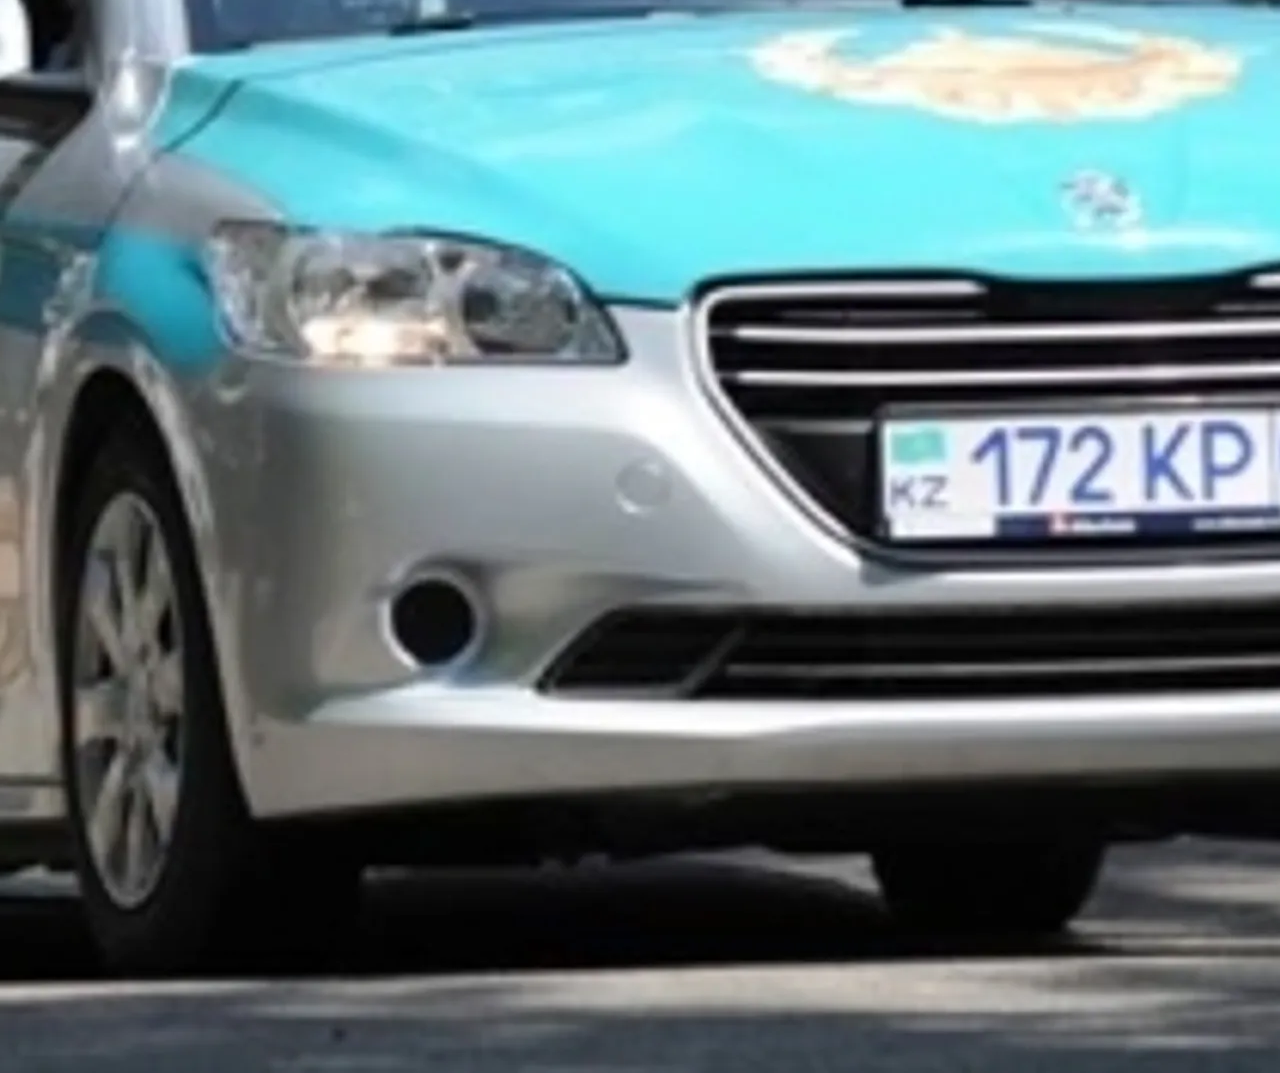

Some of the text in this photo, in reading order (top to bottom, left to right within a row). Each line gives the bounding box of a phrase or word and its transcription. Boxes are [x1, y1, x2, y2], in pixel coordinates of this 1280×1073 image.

[889, 475, 949, 509] KZ
[970, 425, 1116, 506] 172
[1144, 420, 1256, 502] KP
